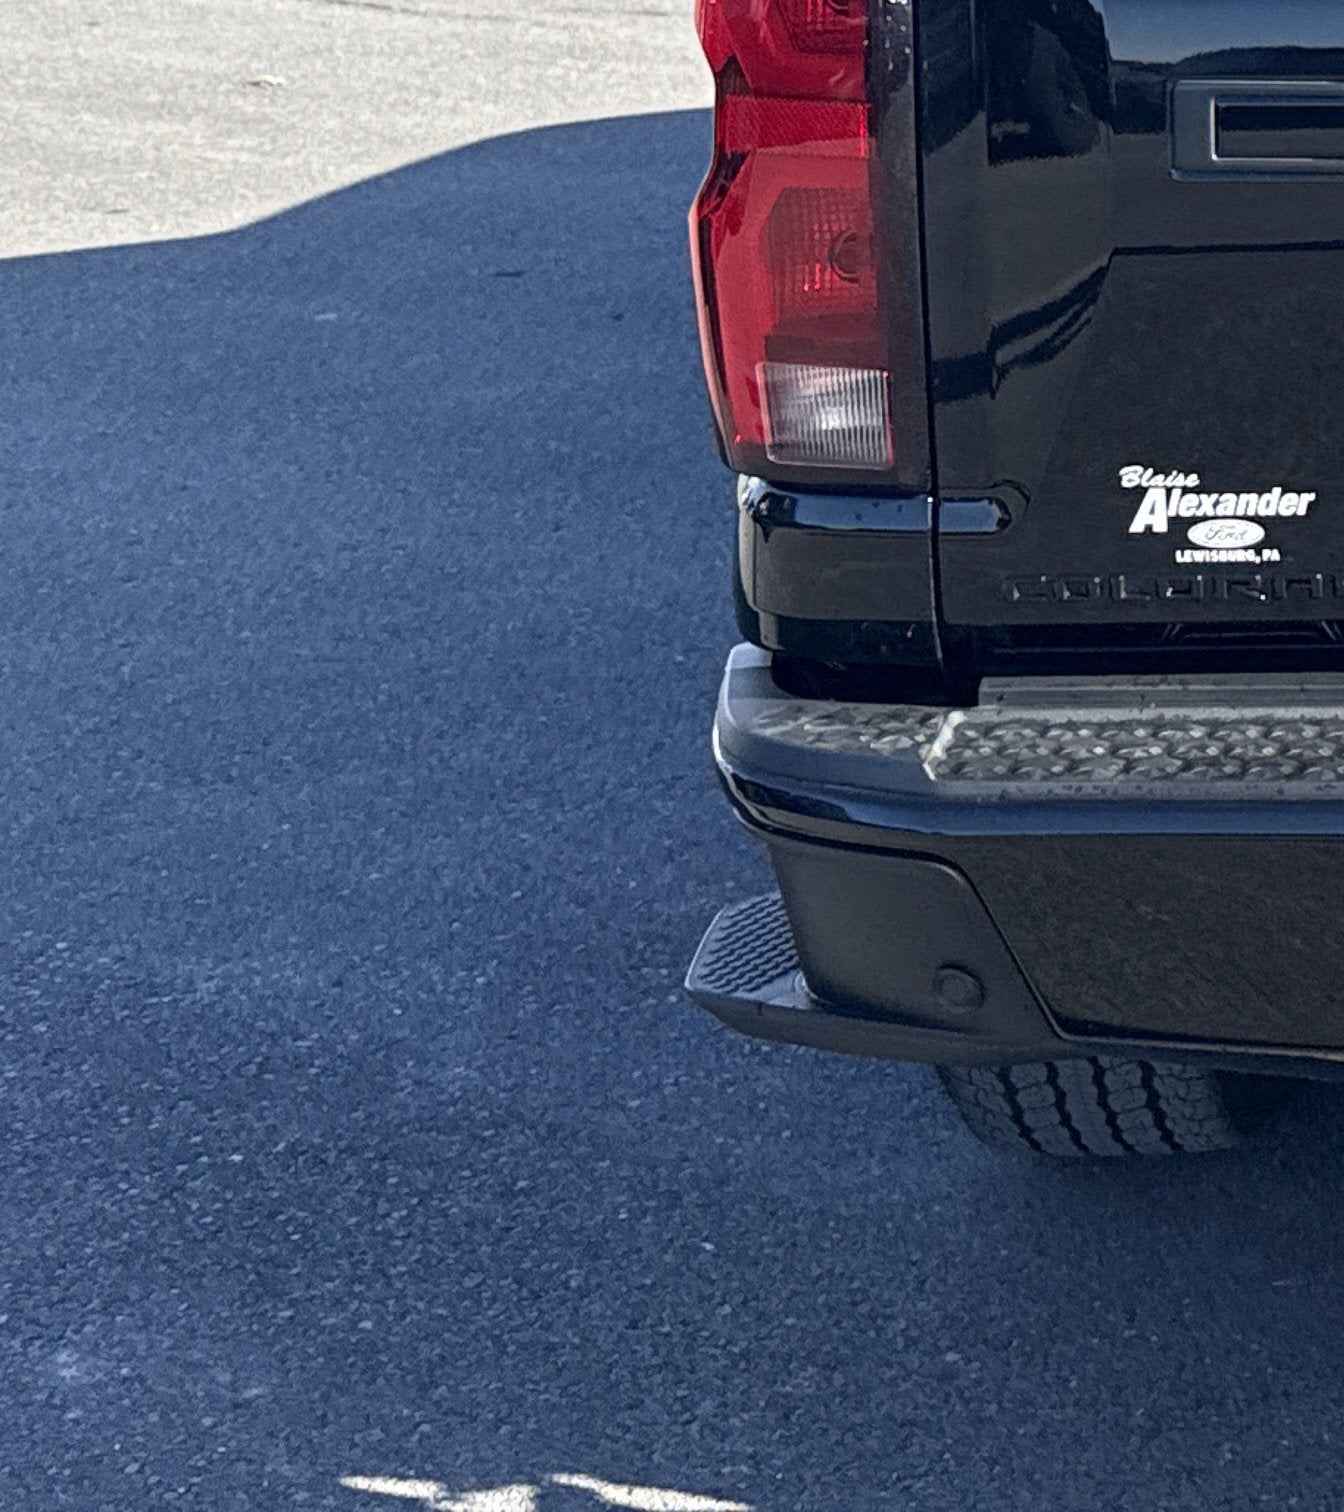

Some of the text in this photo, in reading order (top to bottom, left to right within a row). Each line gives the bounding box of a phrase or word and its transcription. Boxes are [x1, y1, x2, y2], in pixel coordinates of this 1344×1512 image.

[1118, 465, 1201, 489] Blaise
[1128, 487, 1317, 534] Alexander
[1203, 524, 1251, 542] Ford
[1175, 548, 1282, 565] LEWISBURG, PA
